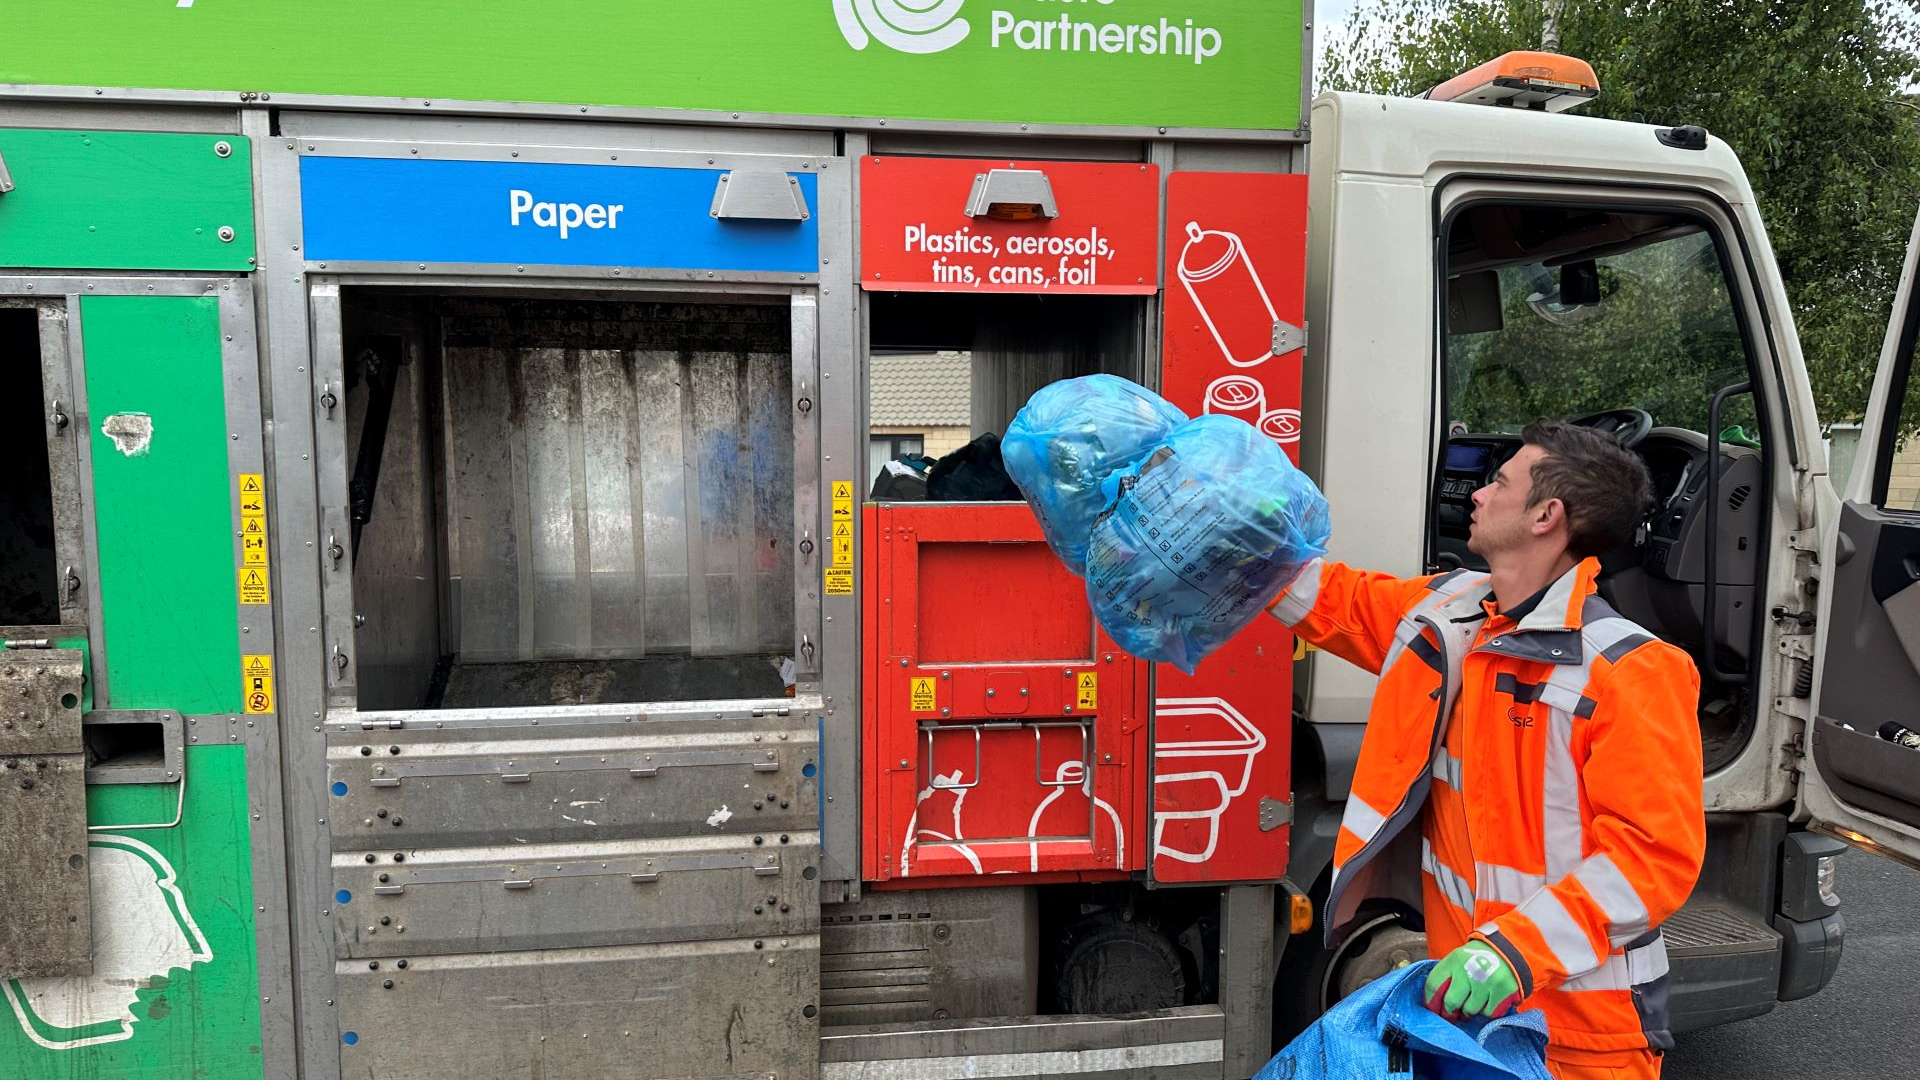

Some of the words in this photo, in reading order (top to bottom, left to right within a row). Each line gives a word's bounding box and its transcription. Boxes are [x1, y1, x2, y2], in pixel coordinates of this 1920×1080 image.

[991, 10, 1222, 64] Partnership
[510, 190, 623, 239] Paper
[904, 223, 1000, 258] Plastics,
[1006, 227, 1116, 260] aerosols,
[932, 256, 981, 287] tins,
[988, 263, 1051, 288] cans,
[1058, 257, 1096, 285] foil
